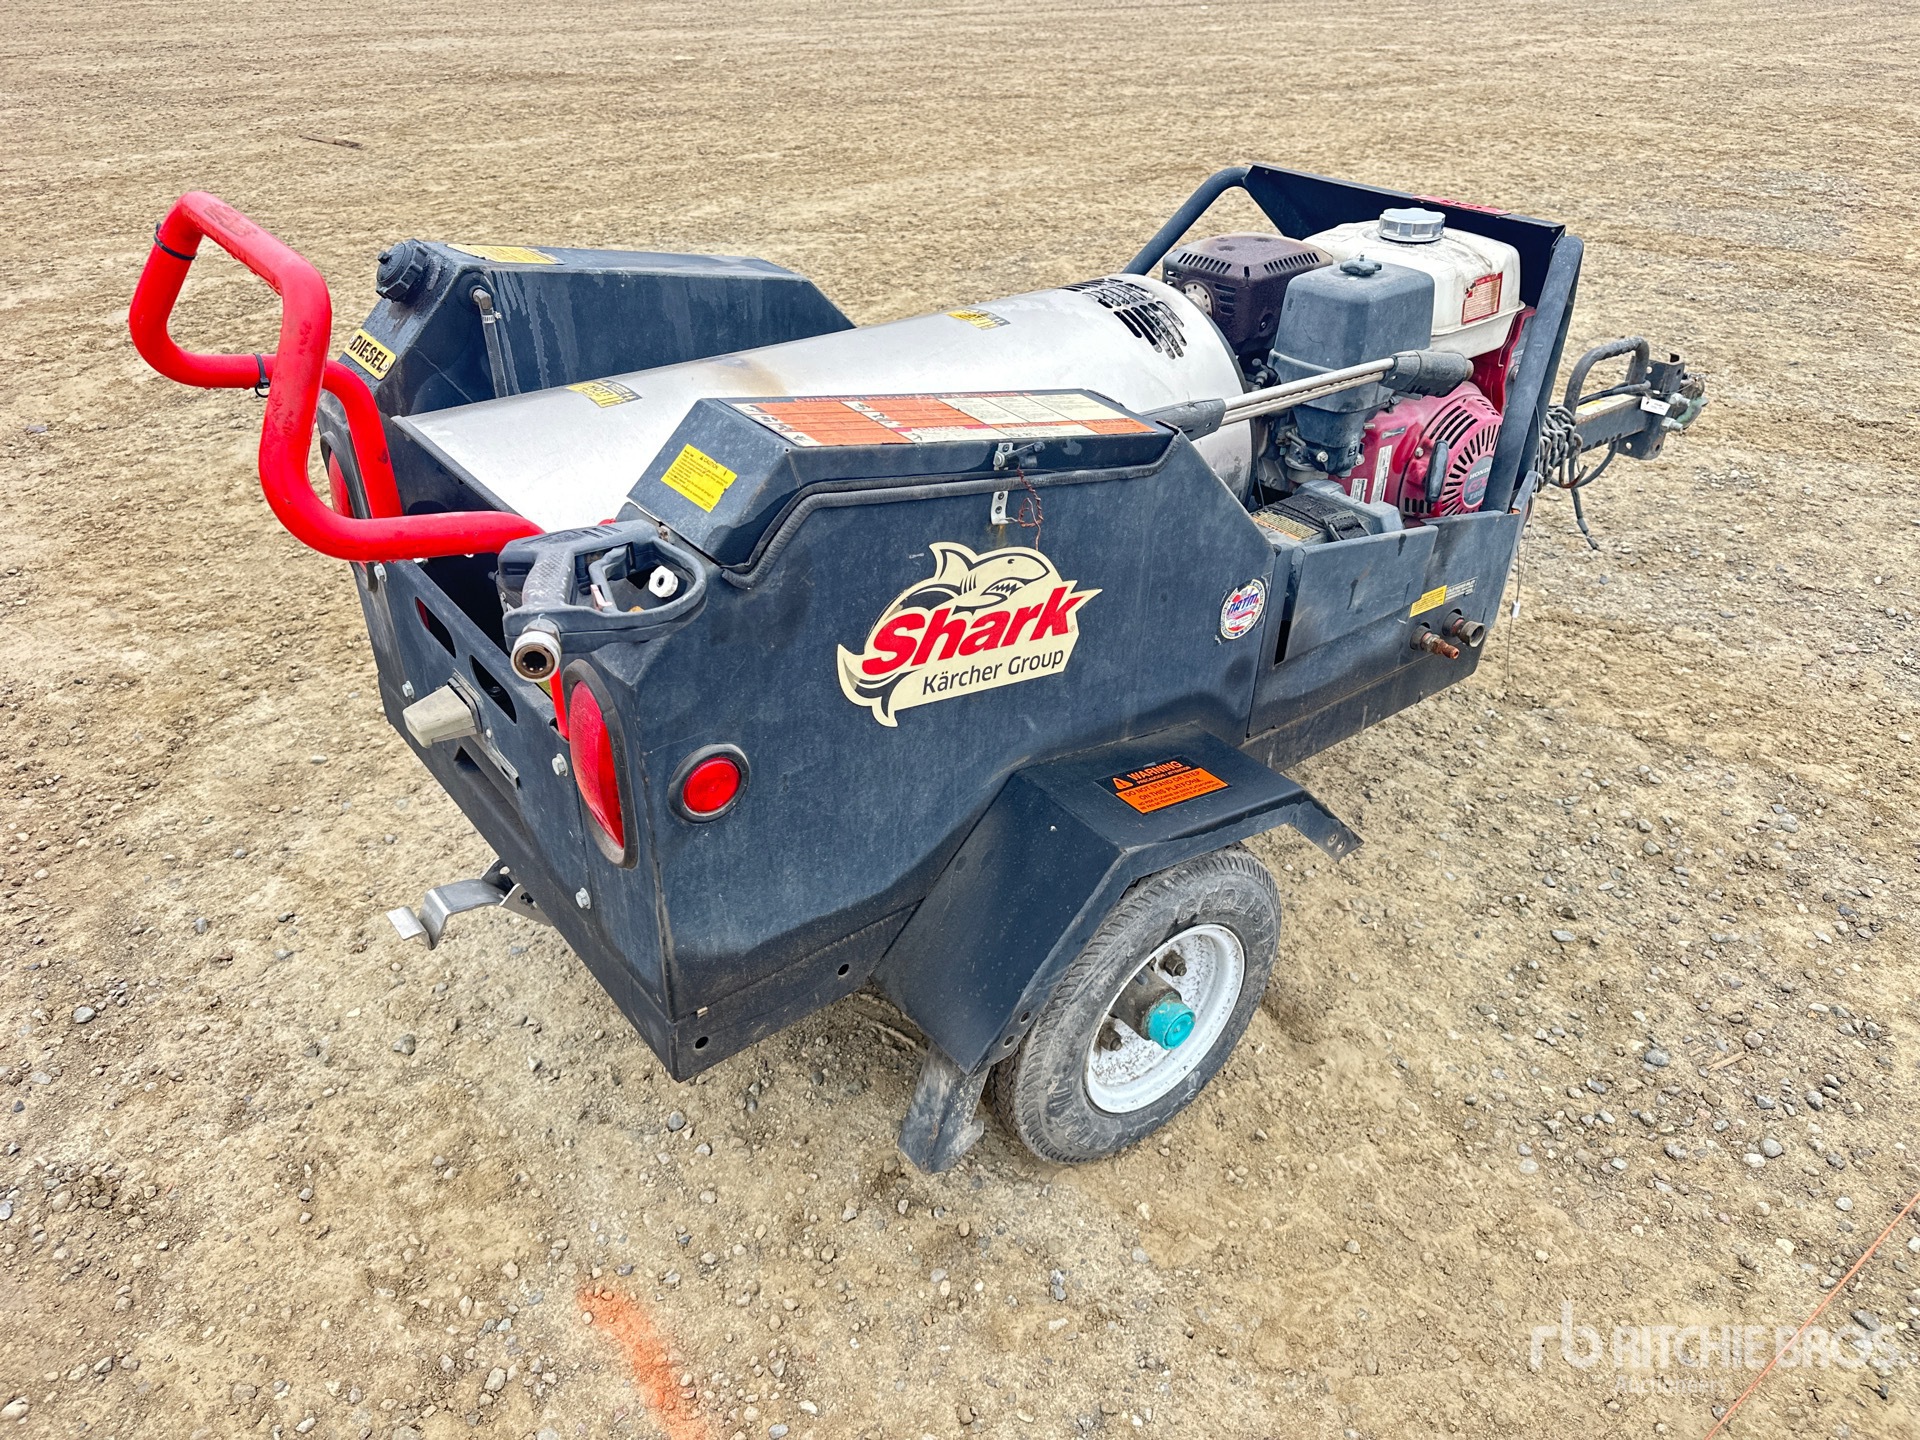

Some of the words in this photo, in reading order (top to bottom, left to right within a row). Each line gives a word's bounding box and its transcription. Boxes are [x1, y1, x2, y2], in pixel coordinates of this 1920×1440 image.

[350, 335, 387, 373] DIESEL
[862, 586, 1085, 675] Shark
[922, 664, 1002, 695] Kärcher
[1008, 649, 1064, 675] Group
[1126, 760, 1183, 780] WARNING
[1149, 779, 1174, 788] STAND
[1183, 770, 1202, 778] STEP
[1148, 788, 1167, 796] THIS
